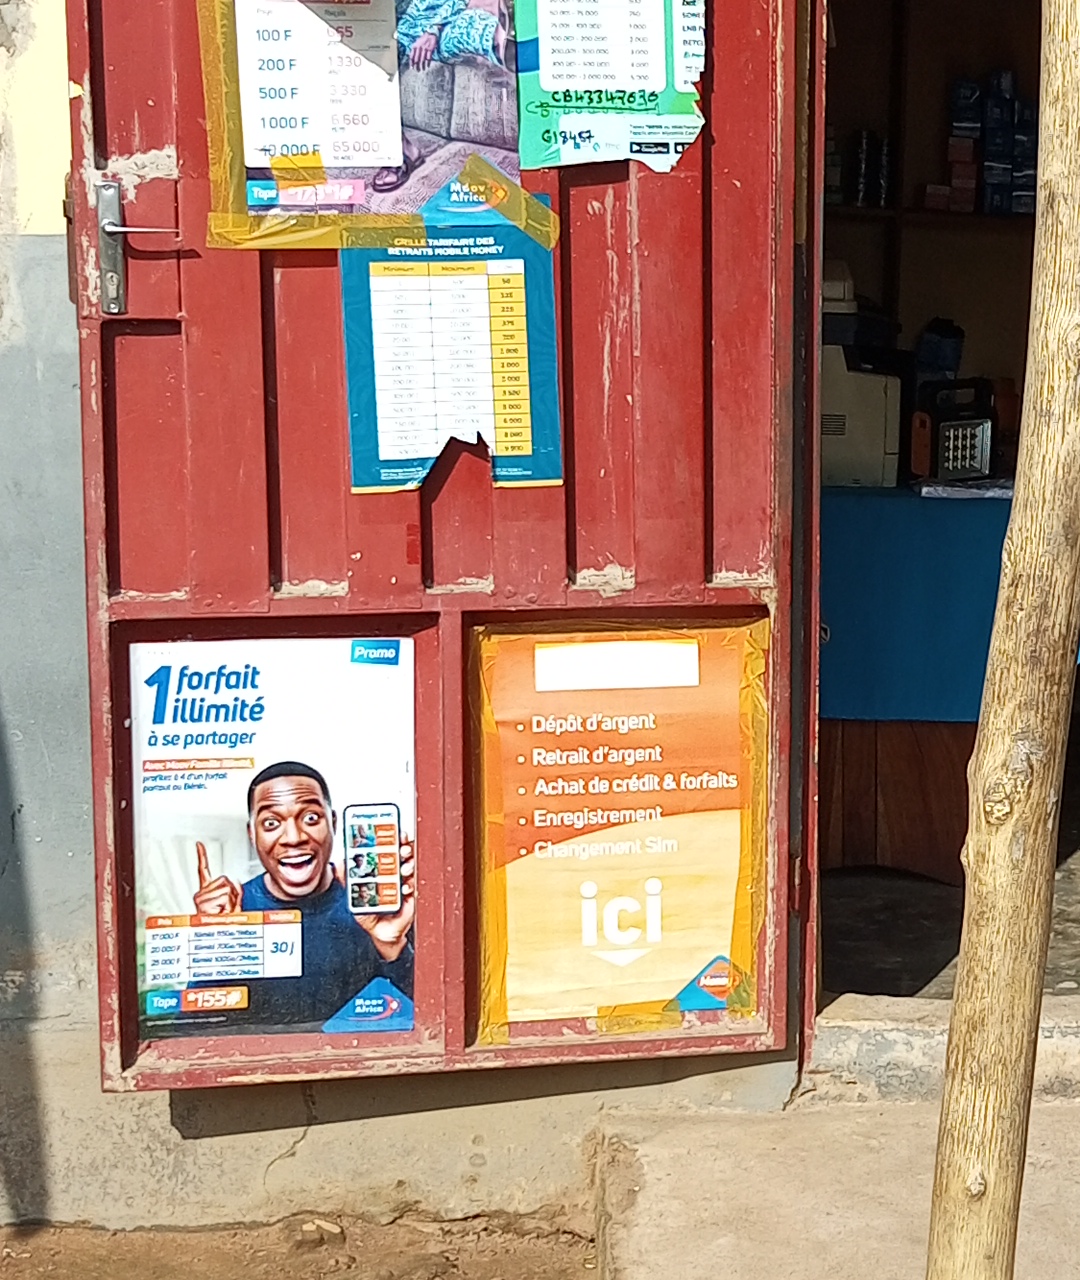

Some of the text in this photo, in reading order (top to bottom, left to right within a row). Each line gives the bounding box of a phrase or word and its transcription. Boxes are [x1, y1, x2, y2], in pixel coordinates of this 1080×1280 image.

[256, 30, 291, 41] 100 F
[258, 59, 297, 71] 200 F
[259, 87, 299, 99] 500 F
[269, 117, 298, 129] 000
[302, 117, 309, 128] F
[280, 144, 309, 156] 000
[313, 144, 320, 155] F
[353, 141, 379, 152] 000
[450, 182, 485, 193] Moov
[450, 193, 486, 202] Africa
[471, 245, 504, 255] MONEY
[354, 646, 396, 659] Promo
[144, 664, 260, 725] 1 forfait
[172, 696, 265, 723] illimité
[531, 713, 656, 736] Dépôt d'argent
[147, 730, 256, 749] à se partager
[532, 746, 663, 767] Retrait d'argent
[534, 771, 738, 796] Achat de crédit & forfaits
[533, 806, 663, 829] Enregistrement
[534, 836, 679, 860] Changement Sim
[579, 876, 663, 947] ici
[270, 941, 288, 953] 30
[152, 996, 178, 1009] Tape
[355, 998, 384, 1006] Moov
